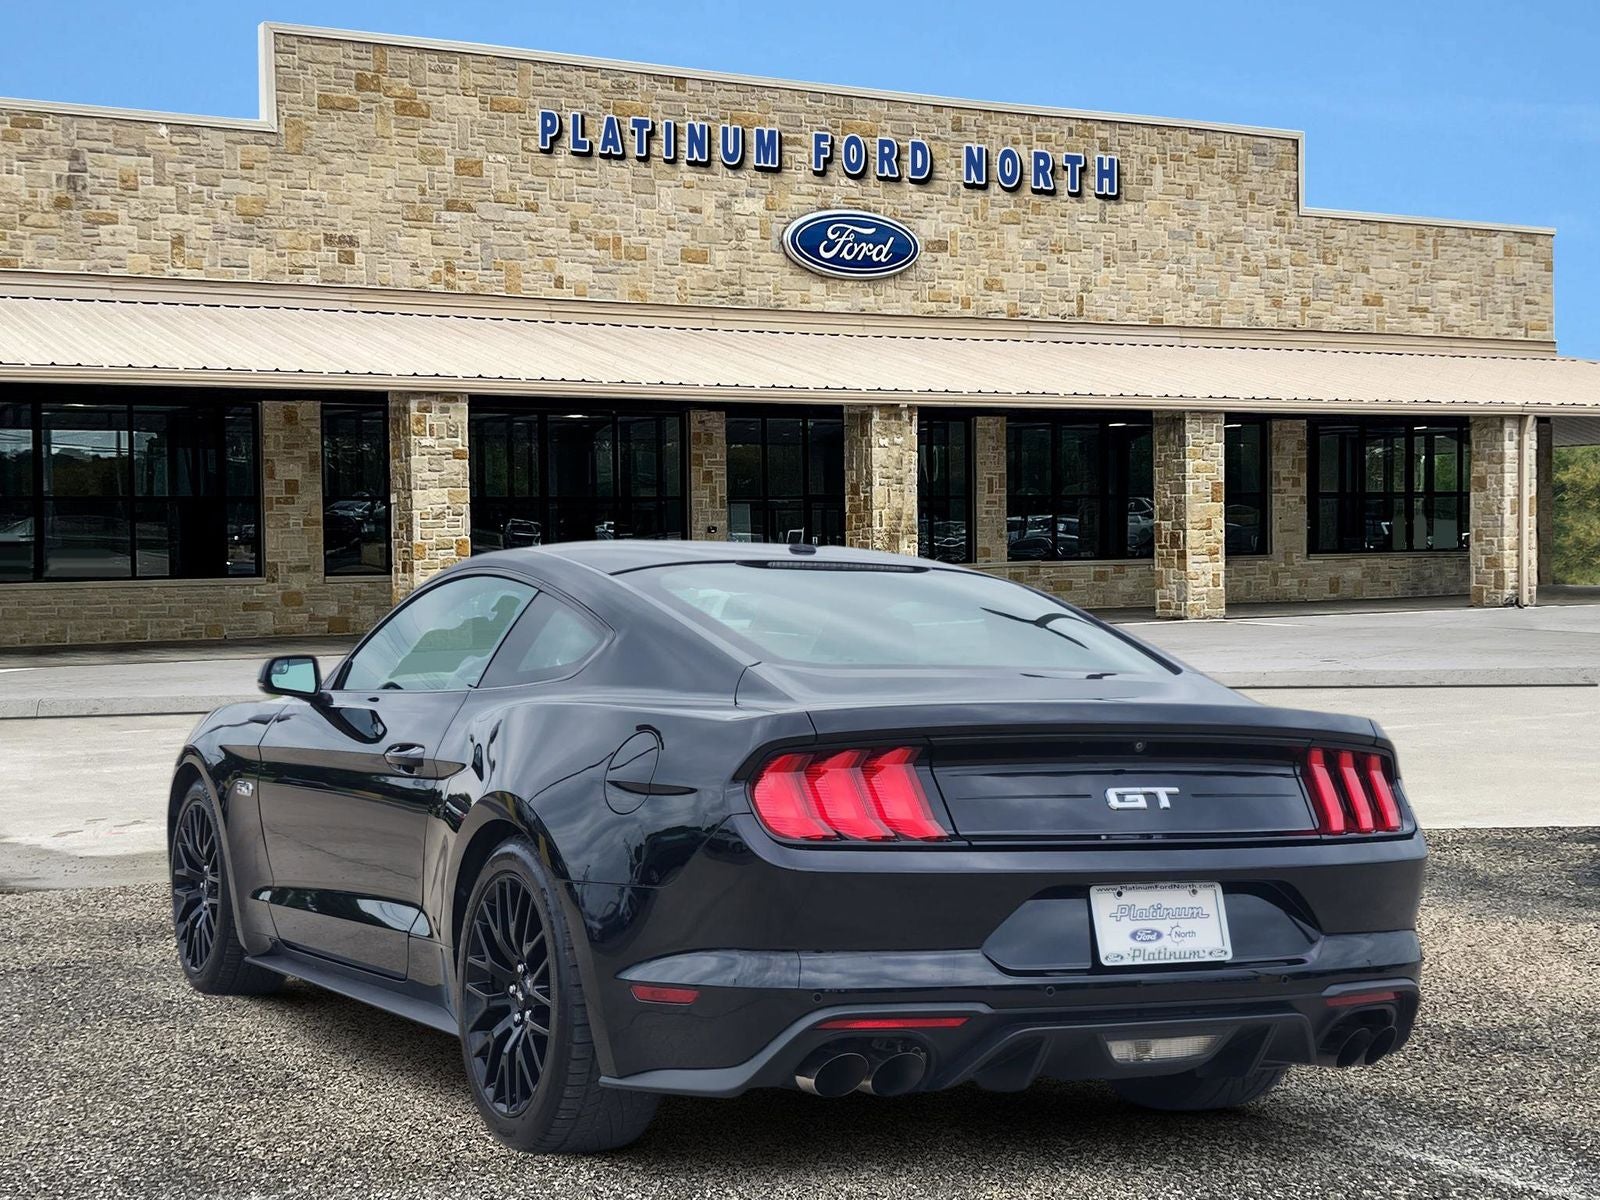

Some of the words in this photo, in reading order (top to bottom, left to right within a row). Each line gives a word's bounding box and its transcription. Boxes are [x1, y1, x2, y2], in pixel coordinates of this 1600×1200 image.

[538, 109, 782, 172] PLATINUM
[813, 131, 934, 183] FORD
[964, 144, 1120, 198] NORTH
[819, 222, 895, 263] Ford
[1105, 786, 1180, 811] GT
[1096, 883, 1216, 892] www.PlatinumFordNorth.com
[1110, 903, 1209, 921] Platinum
[1136, 930, 1157, 942] Ford
[1174, 930, 1197, 939] North
[1127, 946, 1206, 962] Platinum
